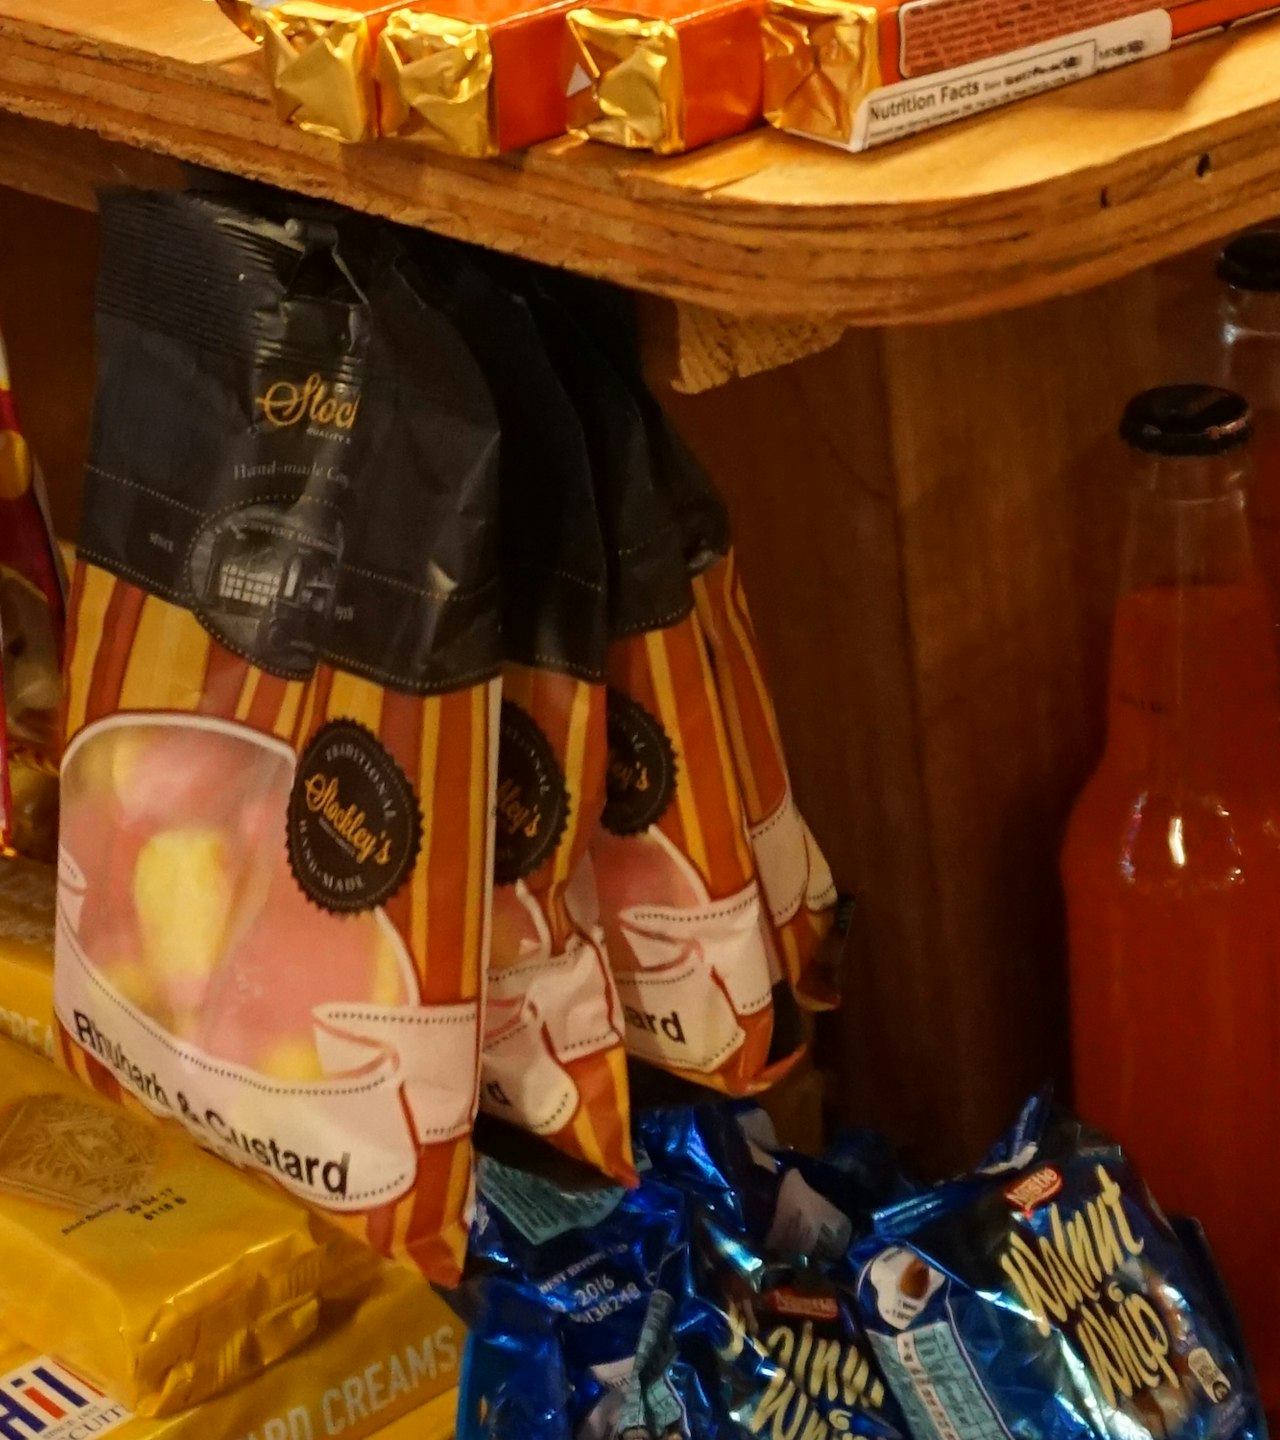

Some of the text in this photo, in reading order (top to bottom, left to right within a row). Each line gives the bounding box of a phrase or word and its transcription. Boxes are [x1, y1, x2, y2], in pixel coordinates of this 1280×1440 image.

[868, 77, 981, 122] Nutrition Facts
[304, 773, 391, 866] Stockley's
[177, 1089, 201, 1131] &
[204, 1107, 353, 1198] Custard
[574, 1272, 616, 1307] 2016
[999, 1163, 1145, 1339] Walnut
[321, 1324, 460, 1437] CREAMS
[1076, 1279, 1181, 1409] Whip
